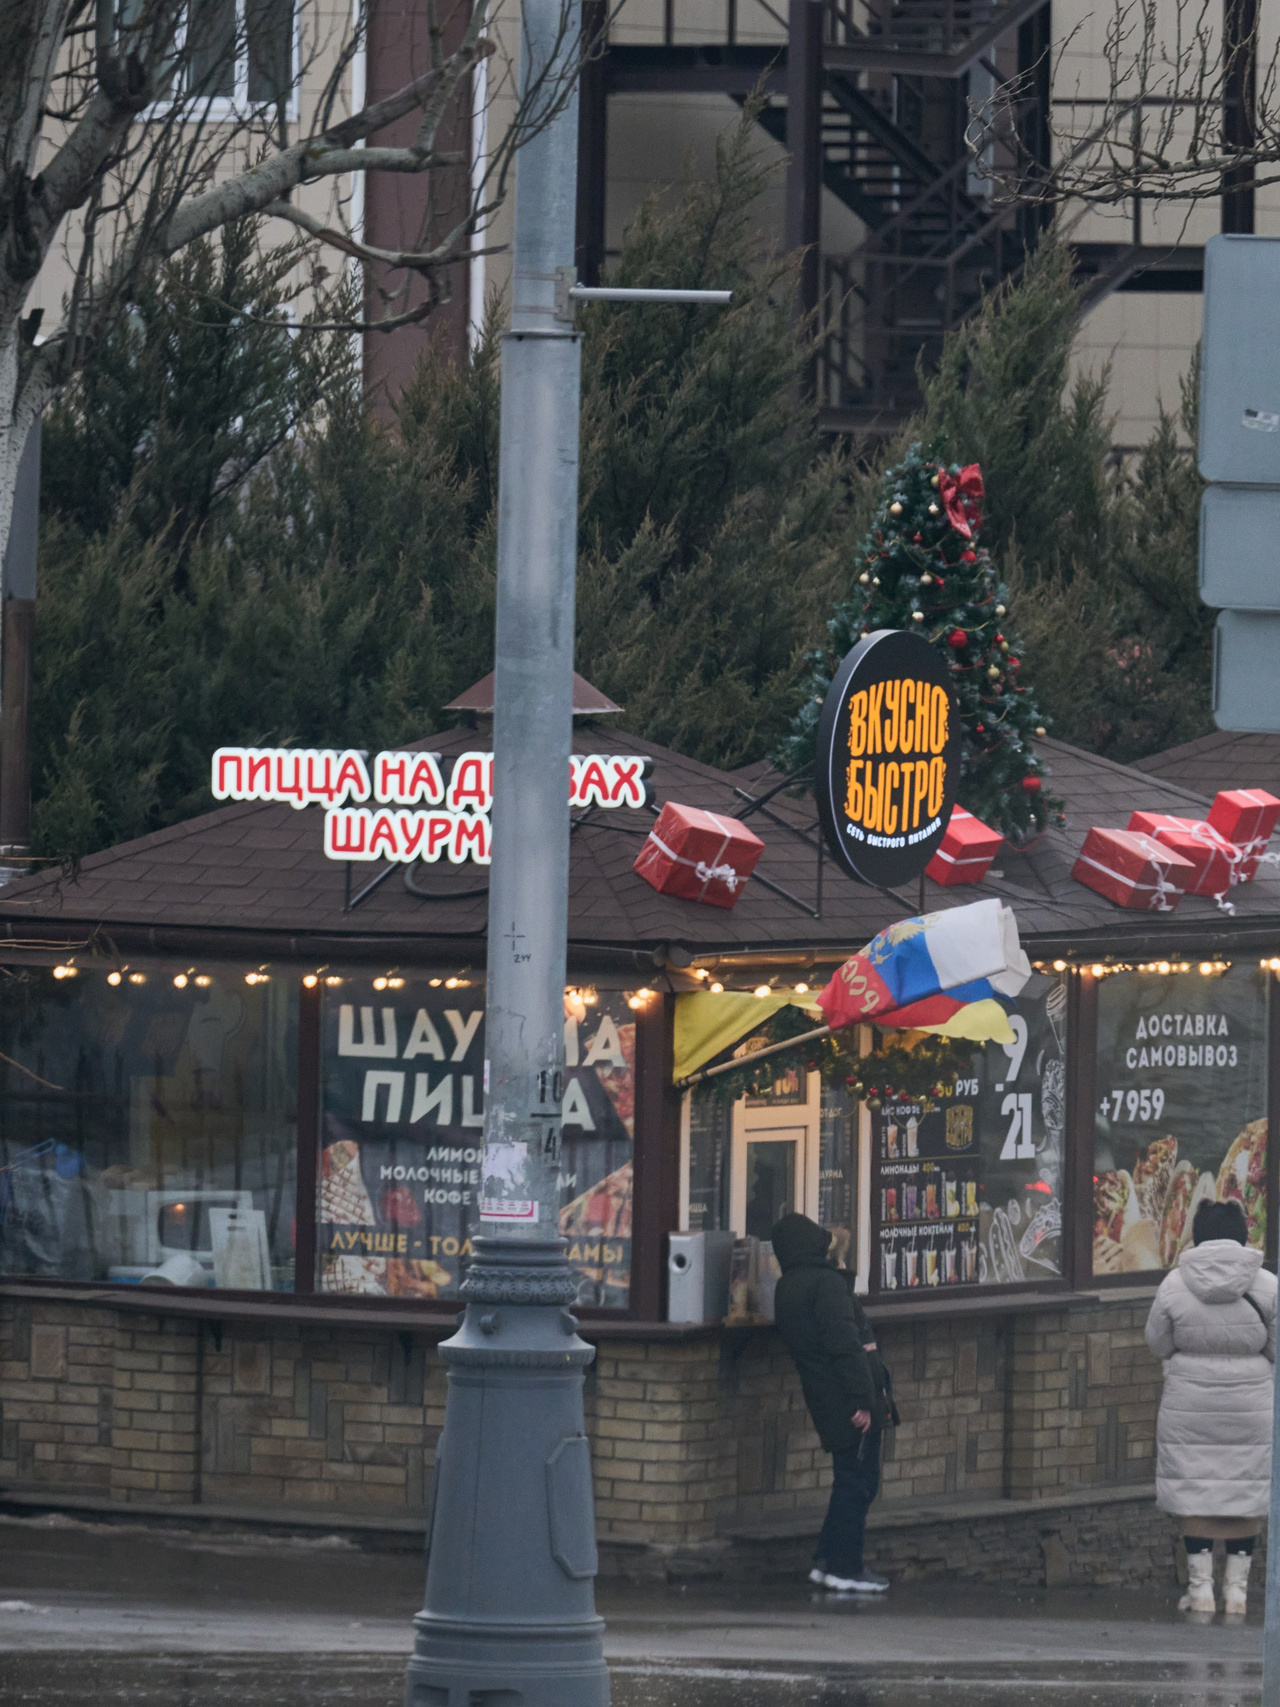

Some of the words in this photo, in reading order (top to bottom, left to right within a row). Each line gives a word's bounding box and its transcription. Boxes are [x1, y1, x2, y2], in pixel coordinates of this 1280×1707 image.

[848, 678, 949, 757] ВКУСНО
[217, 753, 366, 803] ПИЦЦА
[379, 757, 440, 799] НА
[451, 757, 641, 808] ДАХ
[844, 756, 946, 834] БЫСТРО
[330, 812, 492, 859] ШАУРМ
[847, 823, 865, 842] СЕТЬ
[867, 833, 906, 848] БЫСТРОГО
[908, 816, 942, 845] ПИТАНИЯ
[338, 1004, 628, 1068] ШАУА
[1135, 1014, 1229, 1040] ДОСТАВКА
[1126, 1044, 1238, 1069] САМОВЫВОЗ
[361, 1070, 597, 1131] ПИА
[955, 1078, 979, 1097] РУБ
[999, 1092, 1036, 1160] 21
[379, 1165, 479, 1185] МОЛОЧНЫЕ
[423, 1188, 471, 1205] КОФЕ
[330, 1231, 407, 1253] ЛУЧШЕ
[429, 1235, 474, 1257] ТОЛ
[562, 1242, 624, 1263] АМЫ
